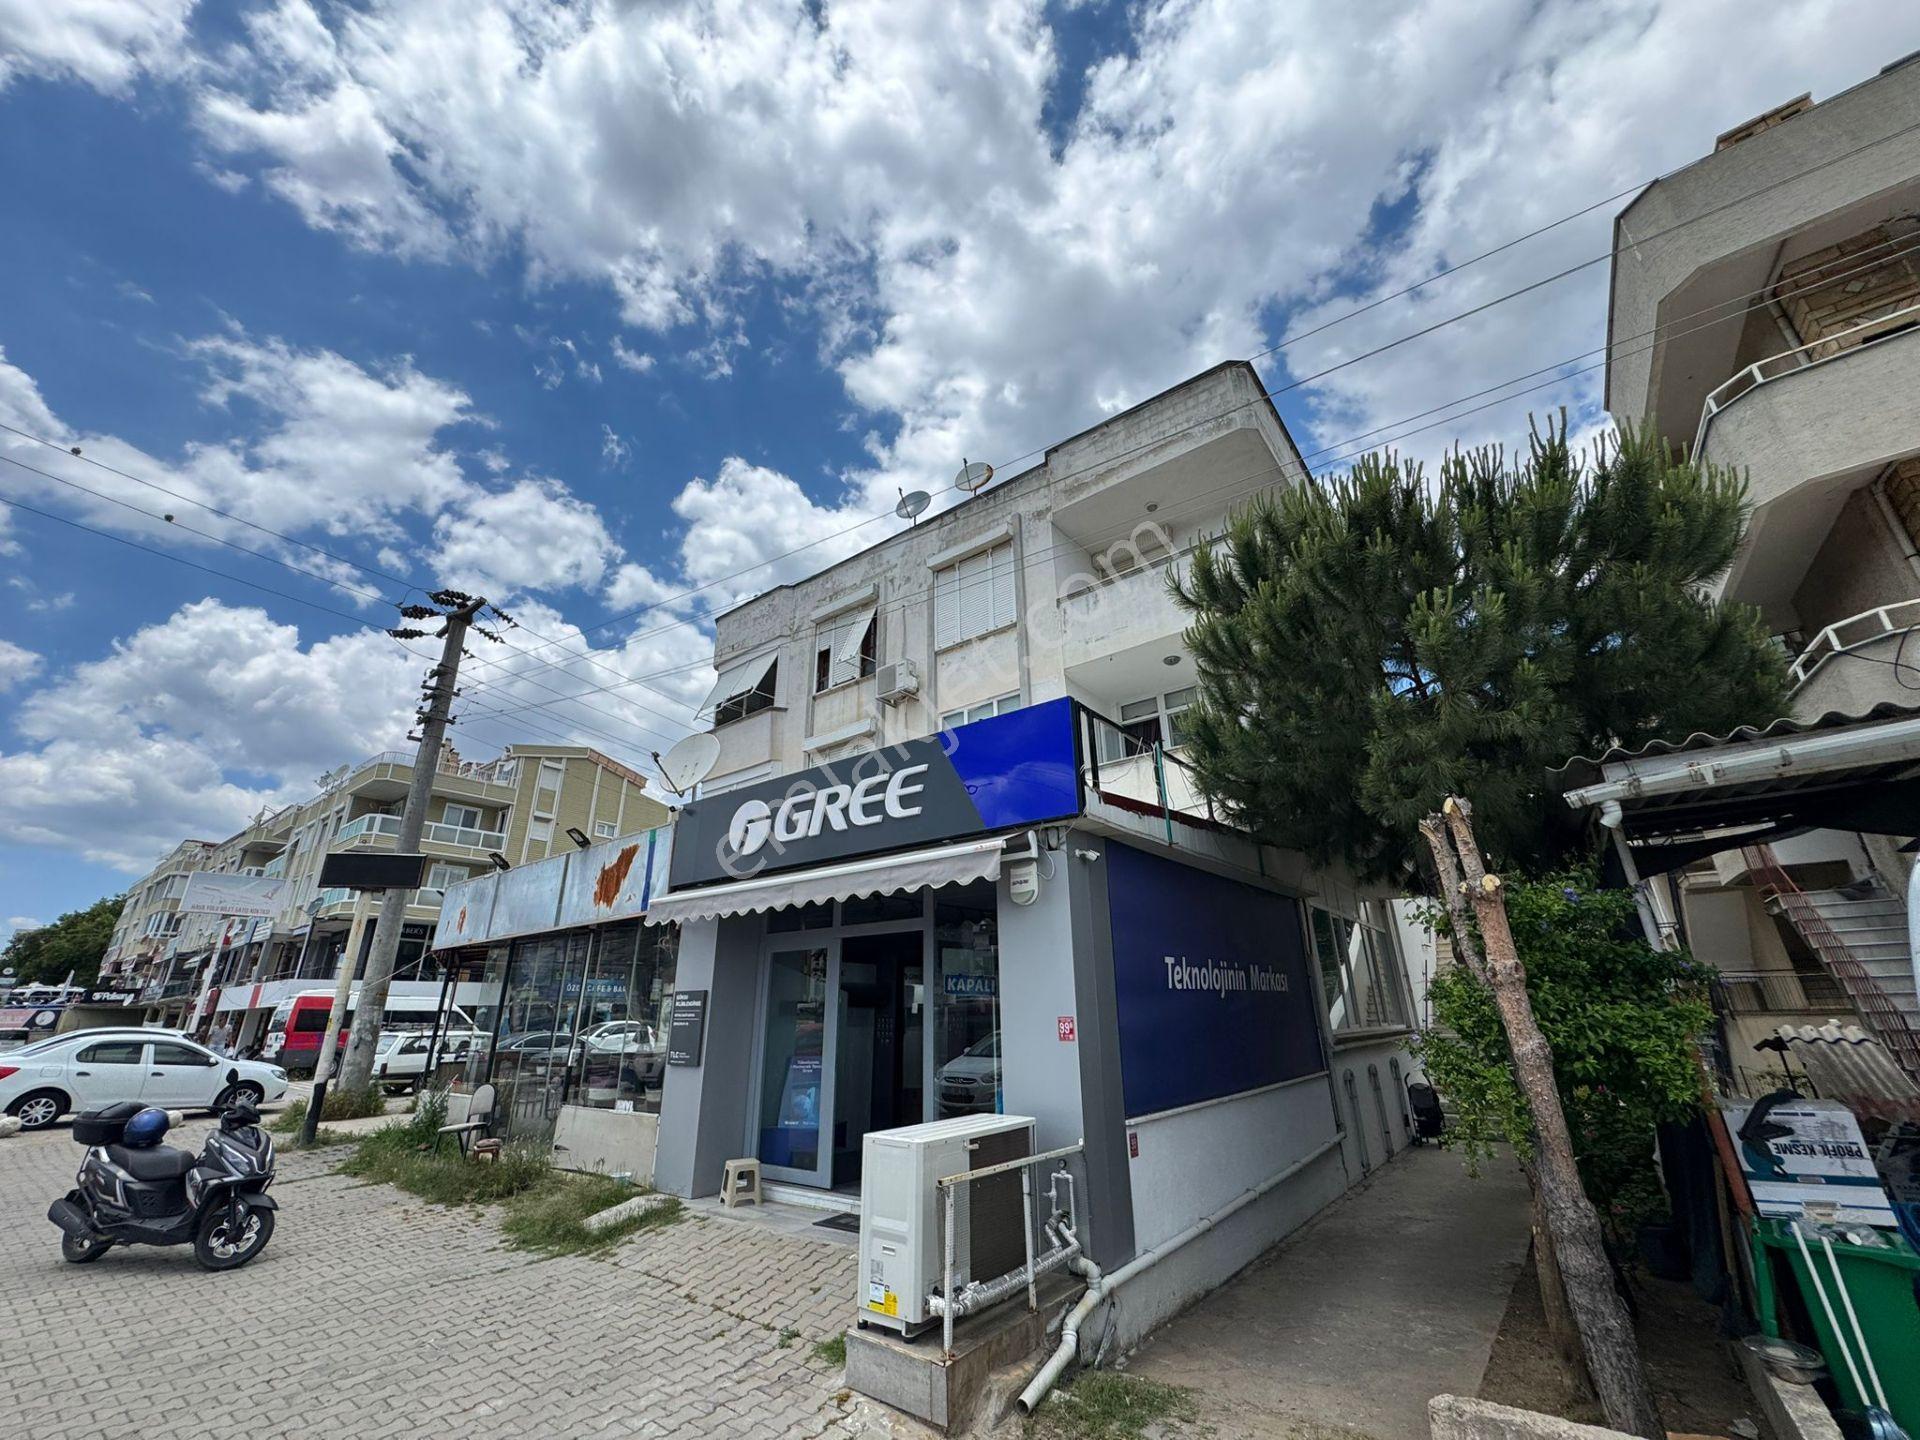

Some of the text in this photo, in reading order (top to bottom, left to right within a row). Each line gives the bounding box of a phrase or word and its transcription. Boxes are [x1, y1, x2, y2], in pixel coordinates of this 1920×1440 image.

[774, 763, 929, 842] GREE
[947, 977, 996, 992] KAPALI
[1164, 956, 1289, 999] Teknolojinin Markası
